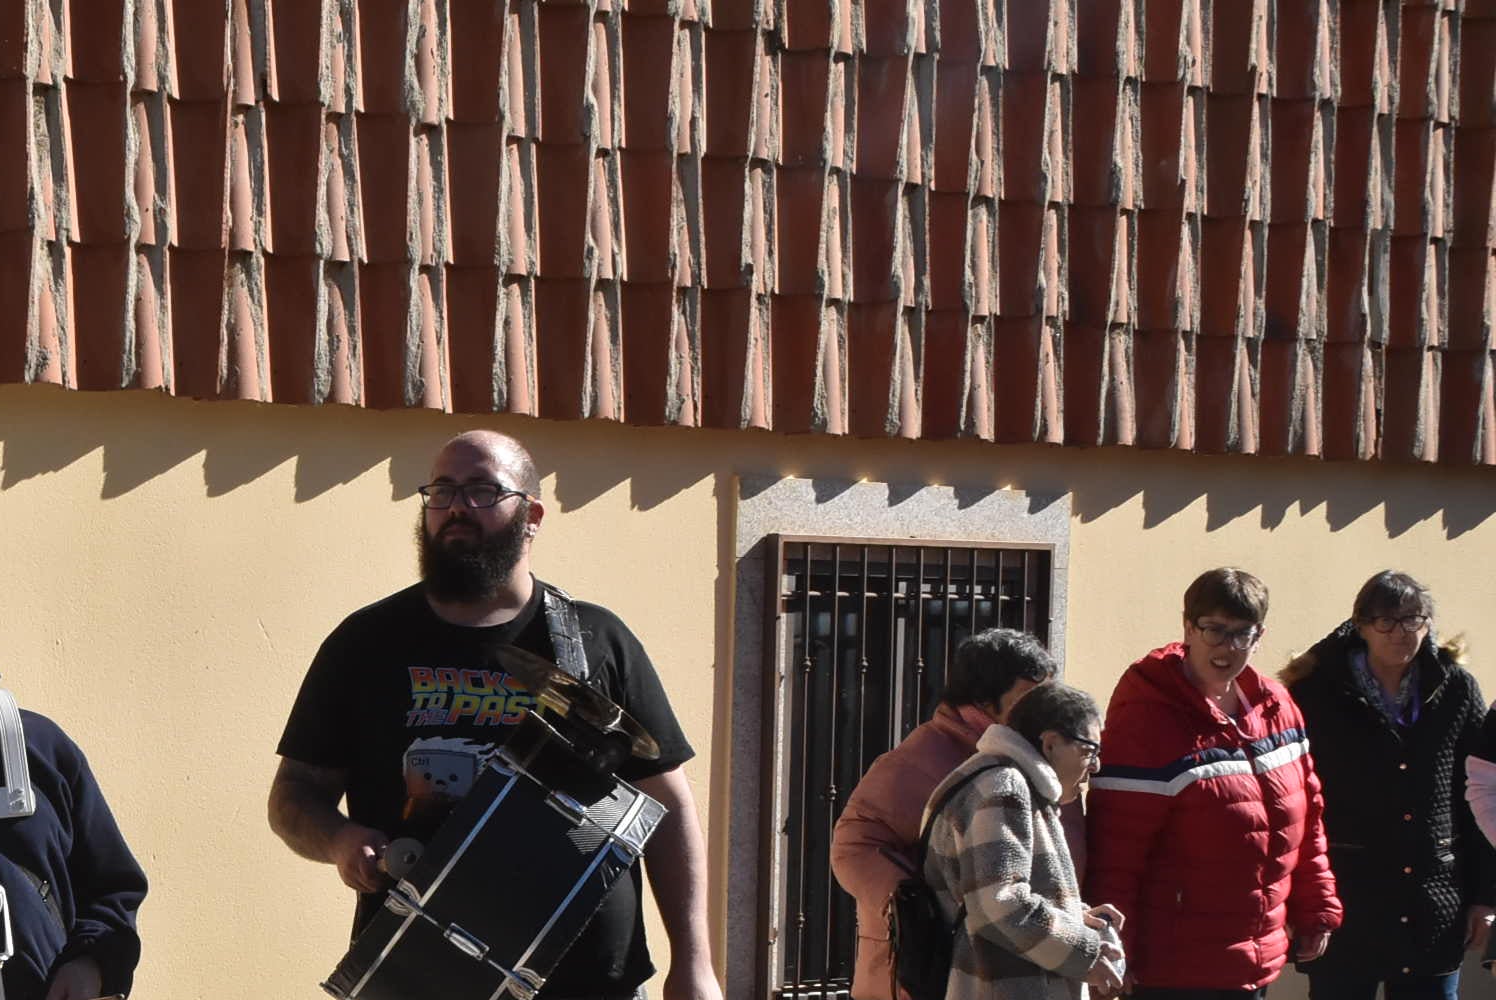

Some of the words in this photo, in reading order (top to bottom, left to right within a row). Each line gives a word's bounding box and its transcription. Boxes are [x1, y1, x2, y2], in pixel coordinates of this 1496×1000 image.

[408, 666, 508, 695] BACK
[411, 692, 448, 710] TO
[406, 709, 449, 728] THE
